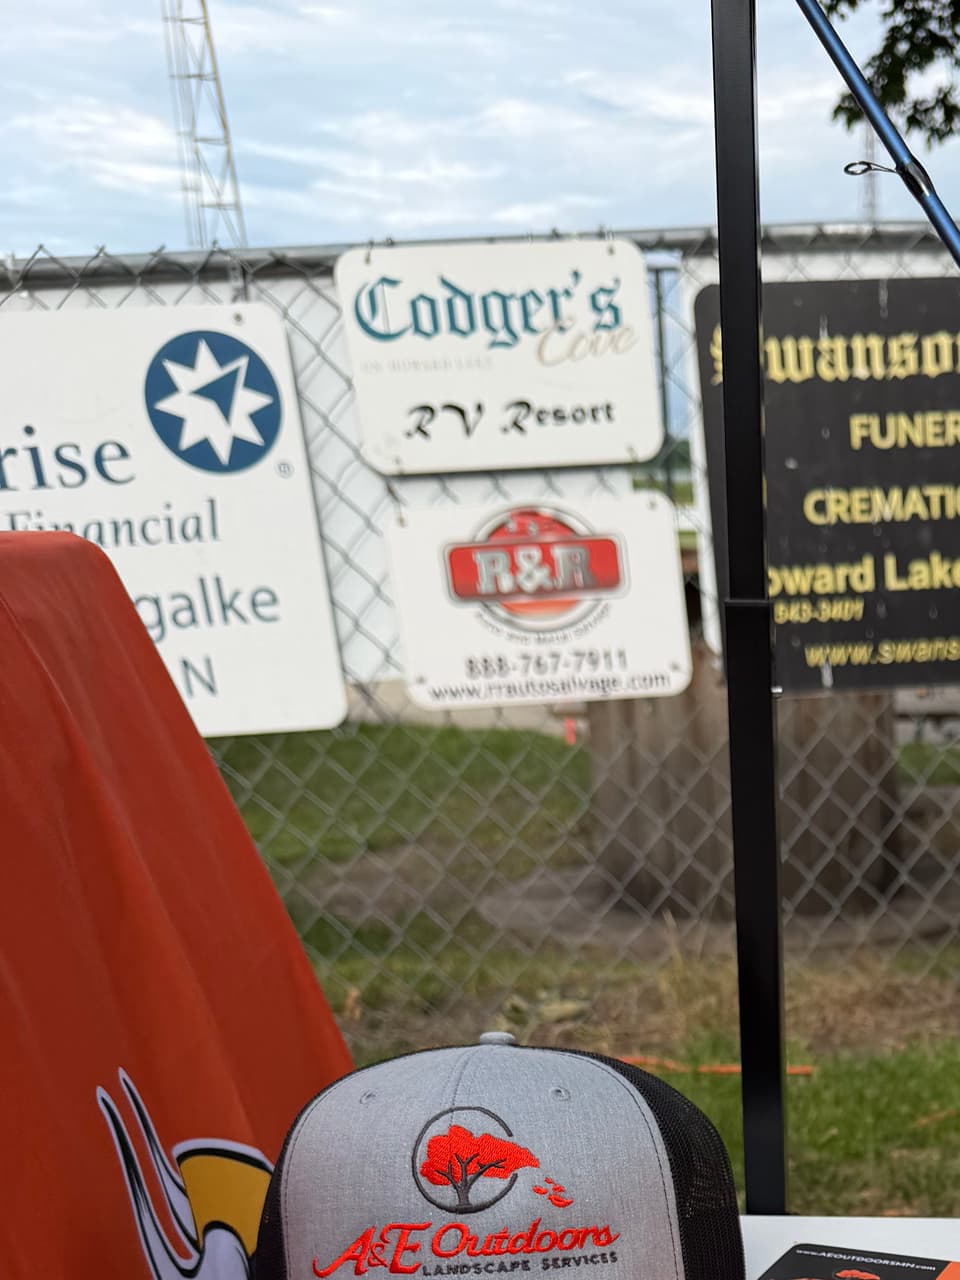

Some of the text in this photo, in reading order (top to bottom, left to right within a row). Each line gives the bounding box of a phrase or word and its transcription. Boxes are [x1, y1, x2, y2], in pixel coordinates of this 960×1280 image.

[354, 268, 622, 350] Codger's
[536, 316, 640, 368] Cove
[404, 399, 616, 440] RV Resort
[472, 544, 602, 595] R&R
[766, 552, 876, 598] oward
[312, 1217, 621, 1279] A&E Outdoors
[422, 1250, 619, 1277] LANDSCAPE SERVICES
